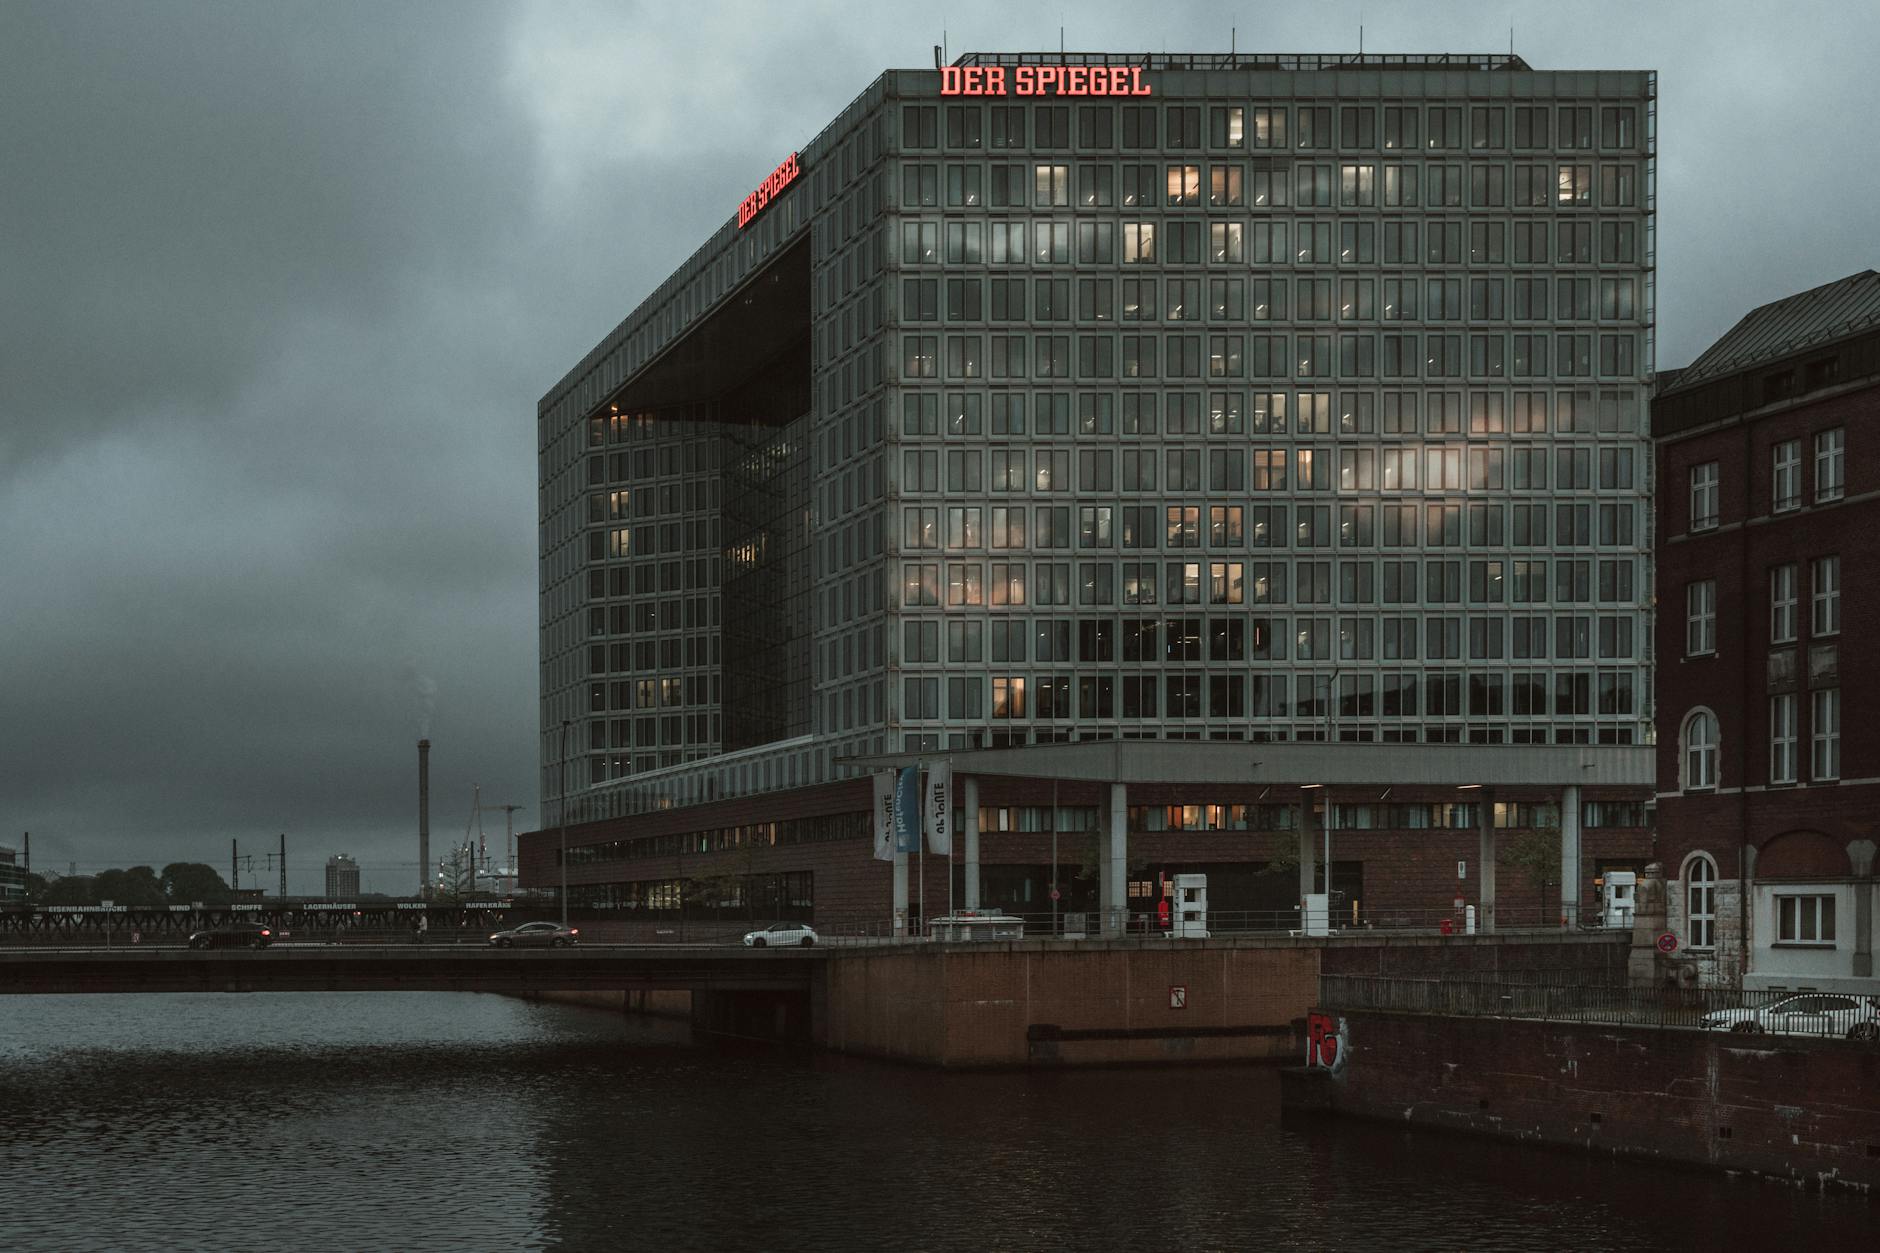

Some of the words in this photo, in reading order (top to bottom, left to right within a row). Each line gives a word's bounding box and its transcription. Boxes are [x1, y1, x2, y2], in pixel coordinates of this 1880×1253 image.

[940, 66, 1007, 96] DER
[1015, 66, 1151, 96] SPIEGEL
[737, 190, 758, 229] DER
[758, 151, 800, 210] SPIEGEL
[168, 904, 191, 912] WIND
[397, 902, 427, 910] WOLKEN
